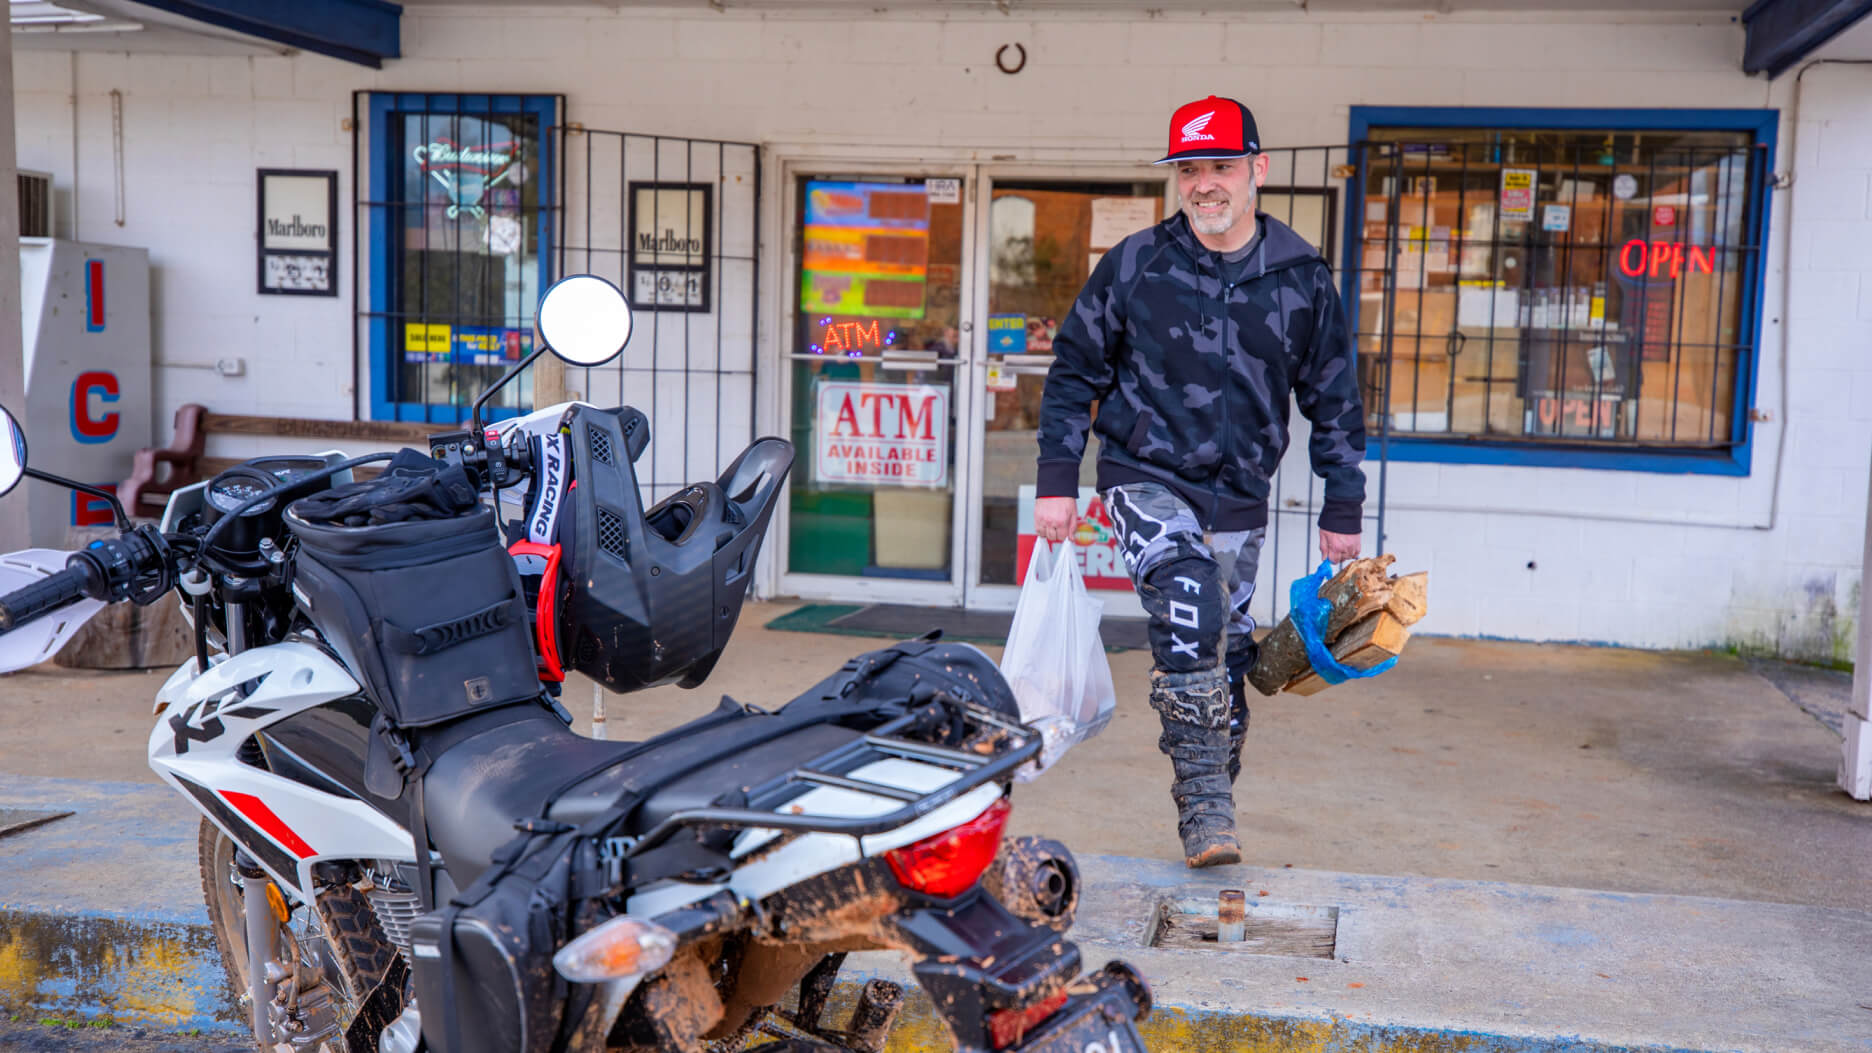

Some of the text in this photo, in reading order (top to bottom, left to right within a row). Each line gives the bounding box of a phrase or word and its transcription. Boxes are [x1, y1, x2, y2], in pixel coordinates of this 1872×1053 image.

[1181, 133, 1215, 143] HONDA
[268, 214, 325, 238] Marlboro
[640, 228, 700, 252] Marlboro
[823, 320, 881, 351] ATM
[988, 317, 1025, 330] ENTER
[69, 259, 121, 527] ICE
[827, 391, 938, 440] ATM
[827, 444, 937, 463] AVAILABLE
[846, 460, 918, 478] INSIDE
[535, 454, 561, 537] RACING
[1169, 576, 1202, 659] FOX
